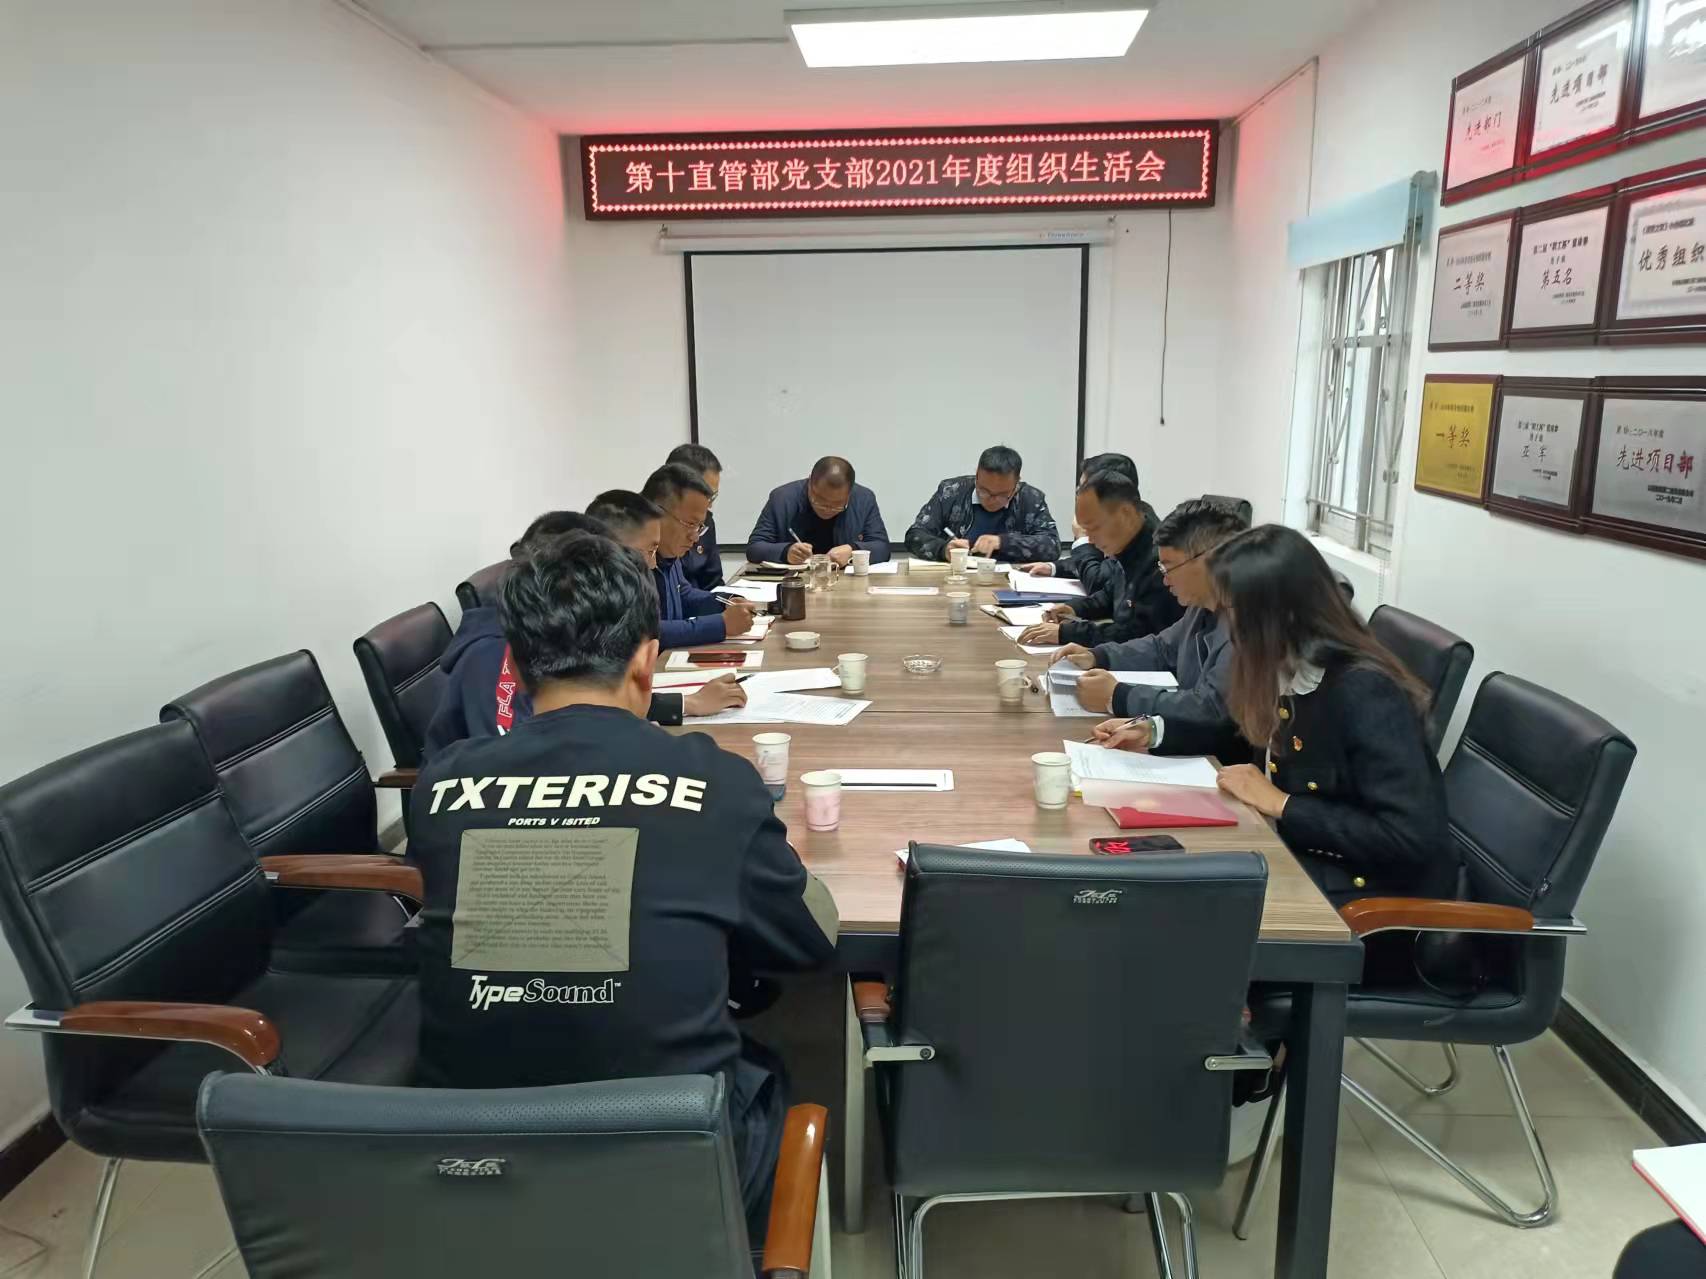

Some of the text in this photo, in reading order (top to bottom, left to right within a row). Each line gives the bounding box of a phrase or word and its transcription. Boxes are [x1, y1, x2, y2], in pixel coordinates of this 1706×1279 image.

[625, 150, 1167, 195] 第十直管部党支部2021年度组织生活会
[1453, 271, 1485, 295] 二等奖
[1541, 267, 1572, 290] 第五名
[1616, 444, 1694, 480] 先进项目部
[429, 773, 707, 815] TXTERISE
